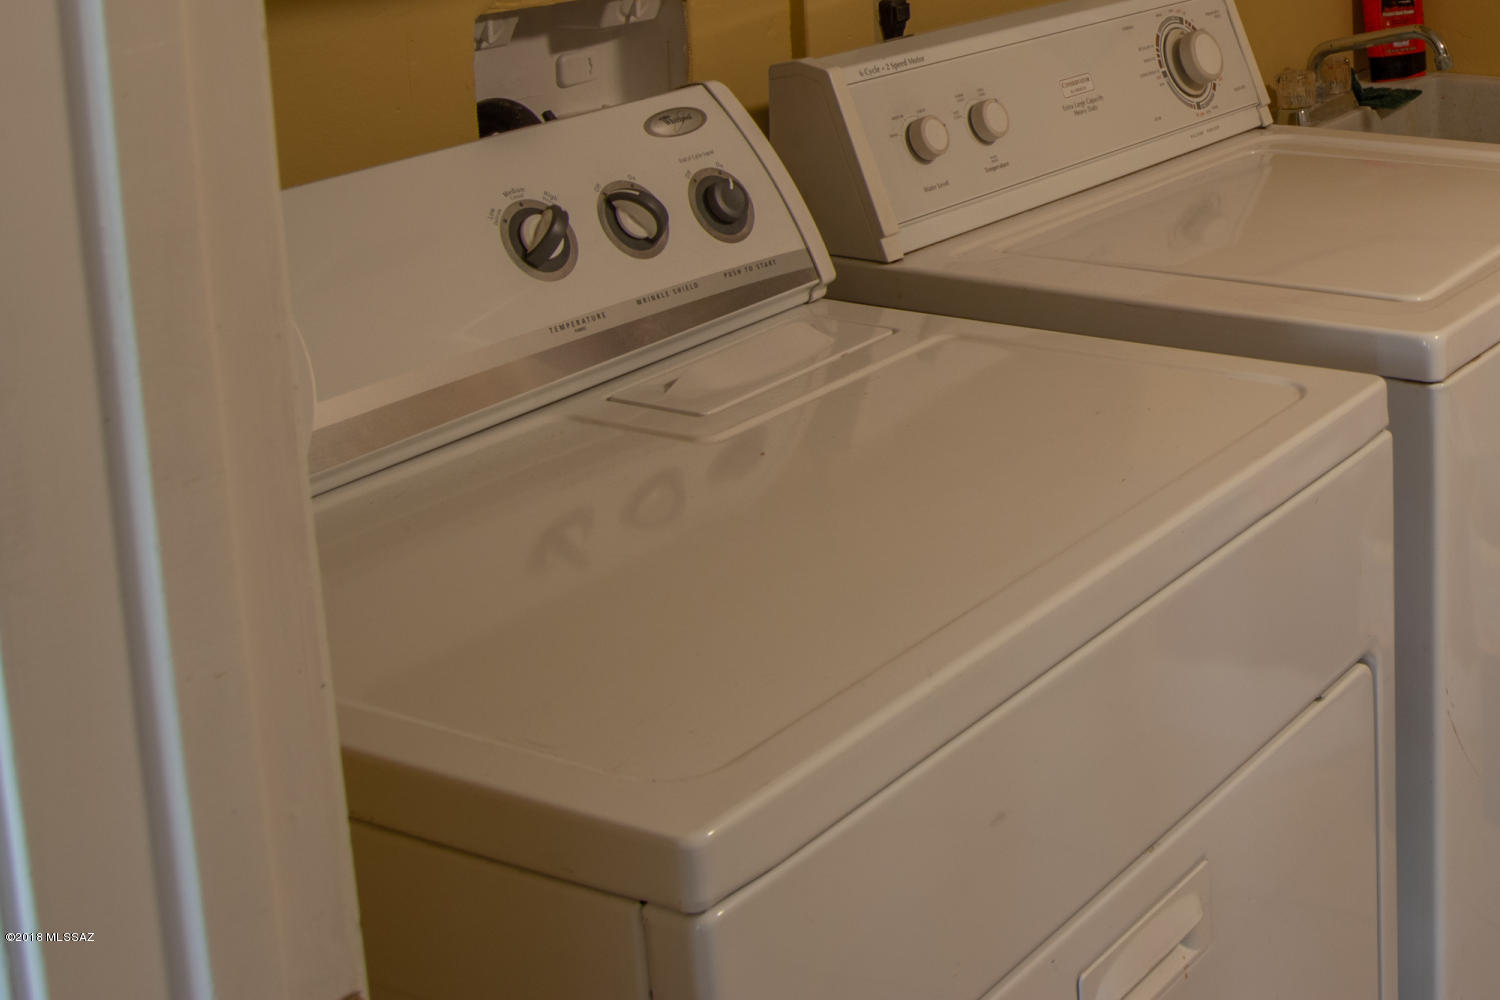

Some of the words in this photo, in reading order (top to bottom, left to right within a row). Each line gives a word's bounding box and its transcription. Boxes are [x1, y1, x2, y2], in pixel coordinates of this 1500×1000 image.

[723, 269, 742, 279] PUSH
[744, 264, 755, 274] TO
[756, 258, 777, 271] START
[636, 290, 670, 306] WRINKLE
[672, 281, 699, 296] SHIELD
[549, 311, 607, 334] TEMPERATURE
